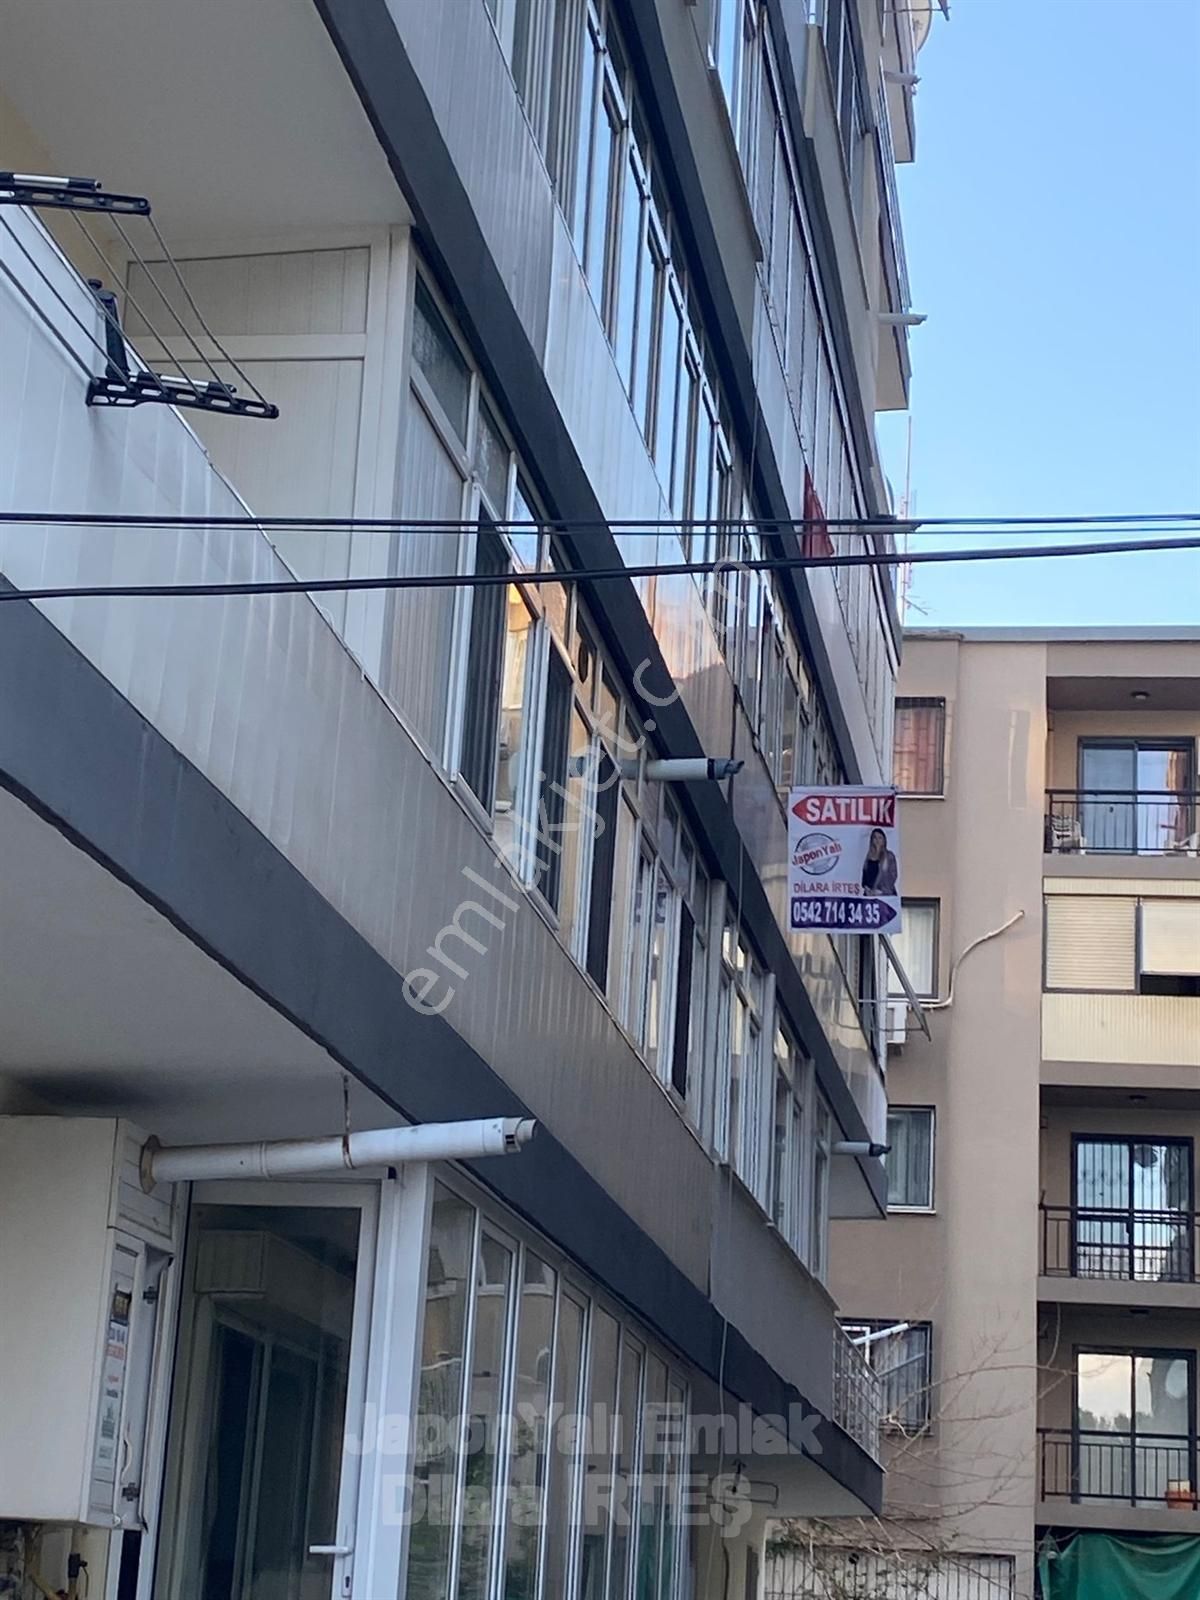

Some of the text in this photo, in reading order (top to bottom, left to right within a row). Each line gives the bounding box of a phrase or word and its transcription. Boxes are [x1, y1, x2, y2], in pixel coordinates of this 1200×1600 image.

[806, 798, 892, 824] SATILIK
[793, 881, 829, 893] DİLARA
[793, 902, 880, 924] 0542 714 34 35
